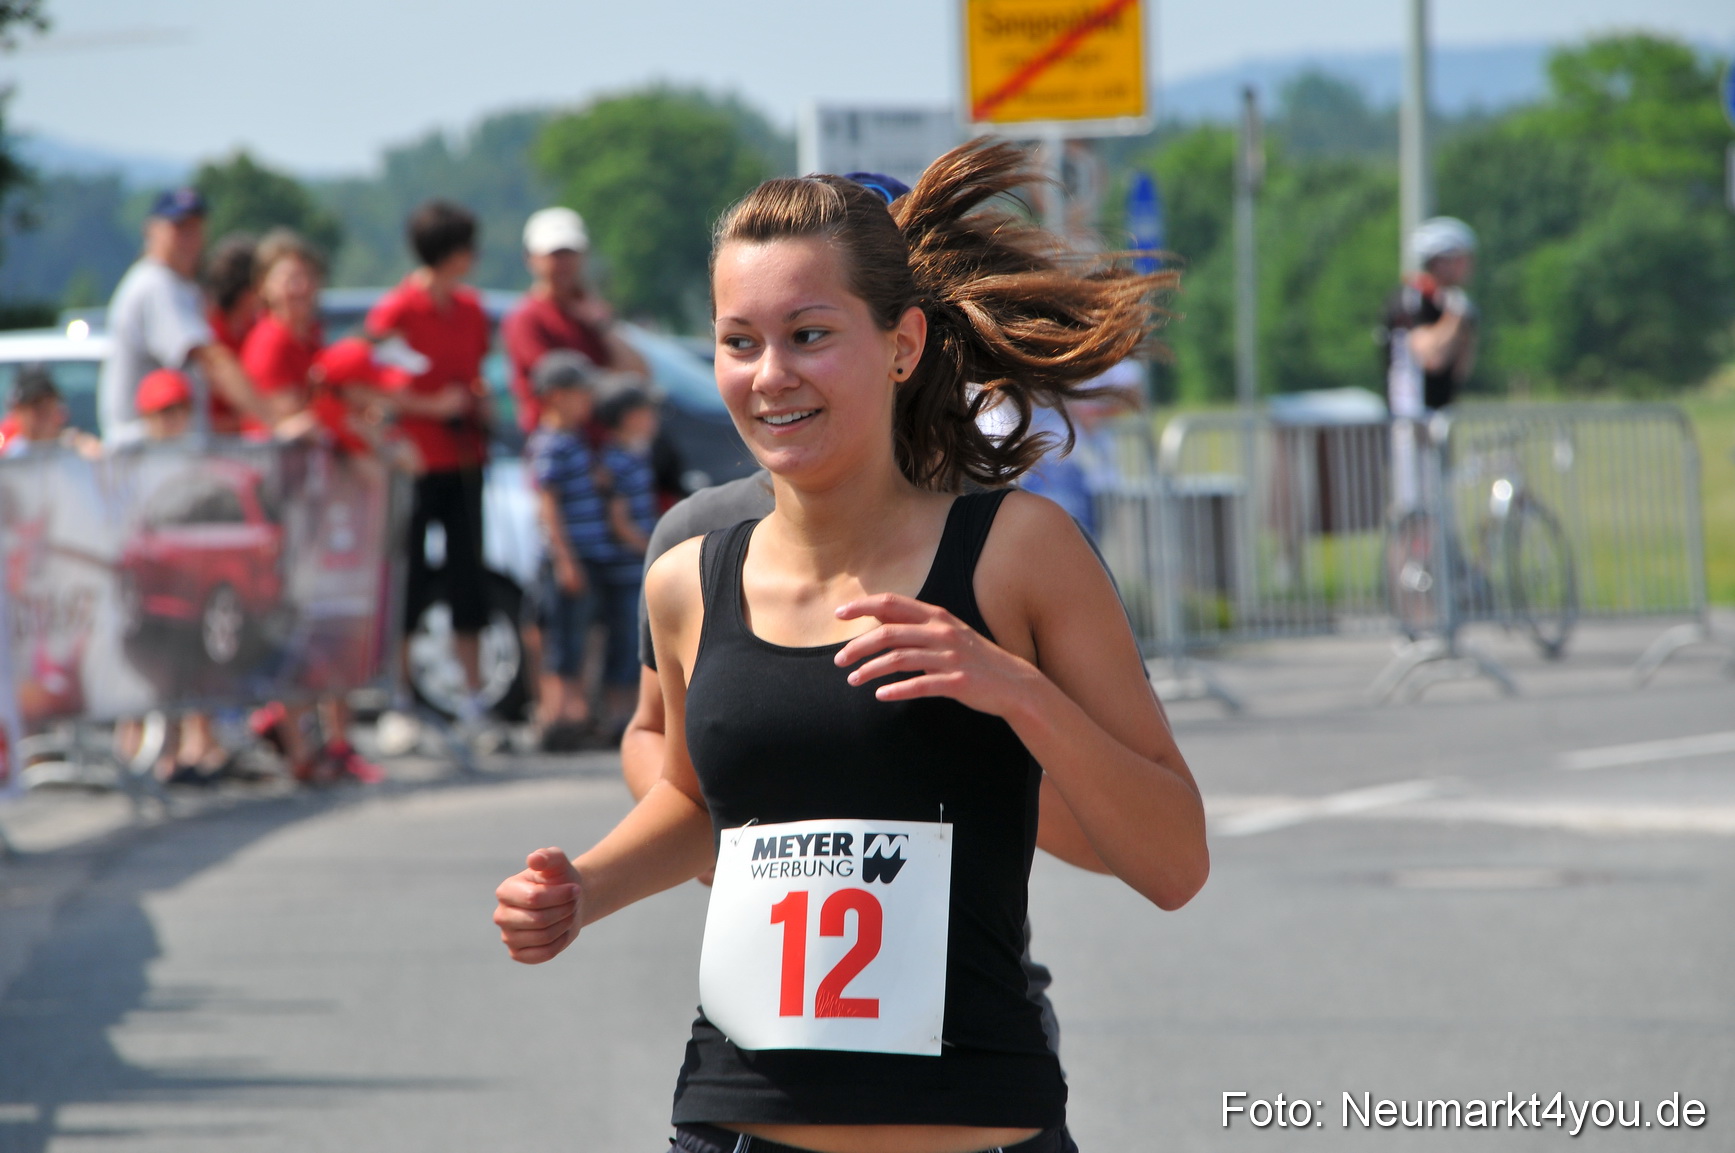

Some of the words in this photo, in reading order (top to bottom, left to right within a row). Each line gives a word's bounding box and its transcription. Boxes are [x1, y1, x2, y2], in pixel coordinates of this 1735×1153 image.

[751, 832, 854, 861] MEYER
[751, 859, 854, 880] WERBUNG
[770, 887, 883, 1019] 12
